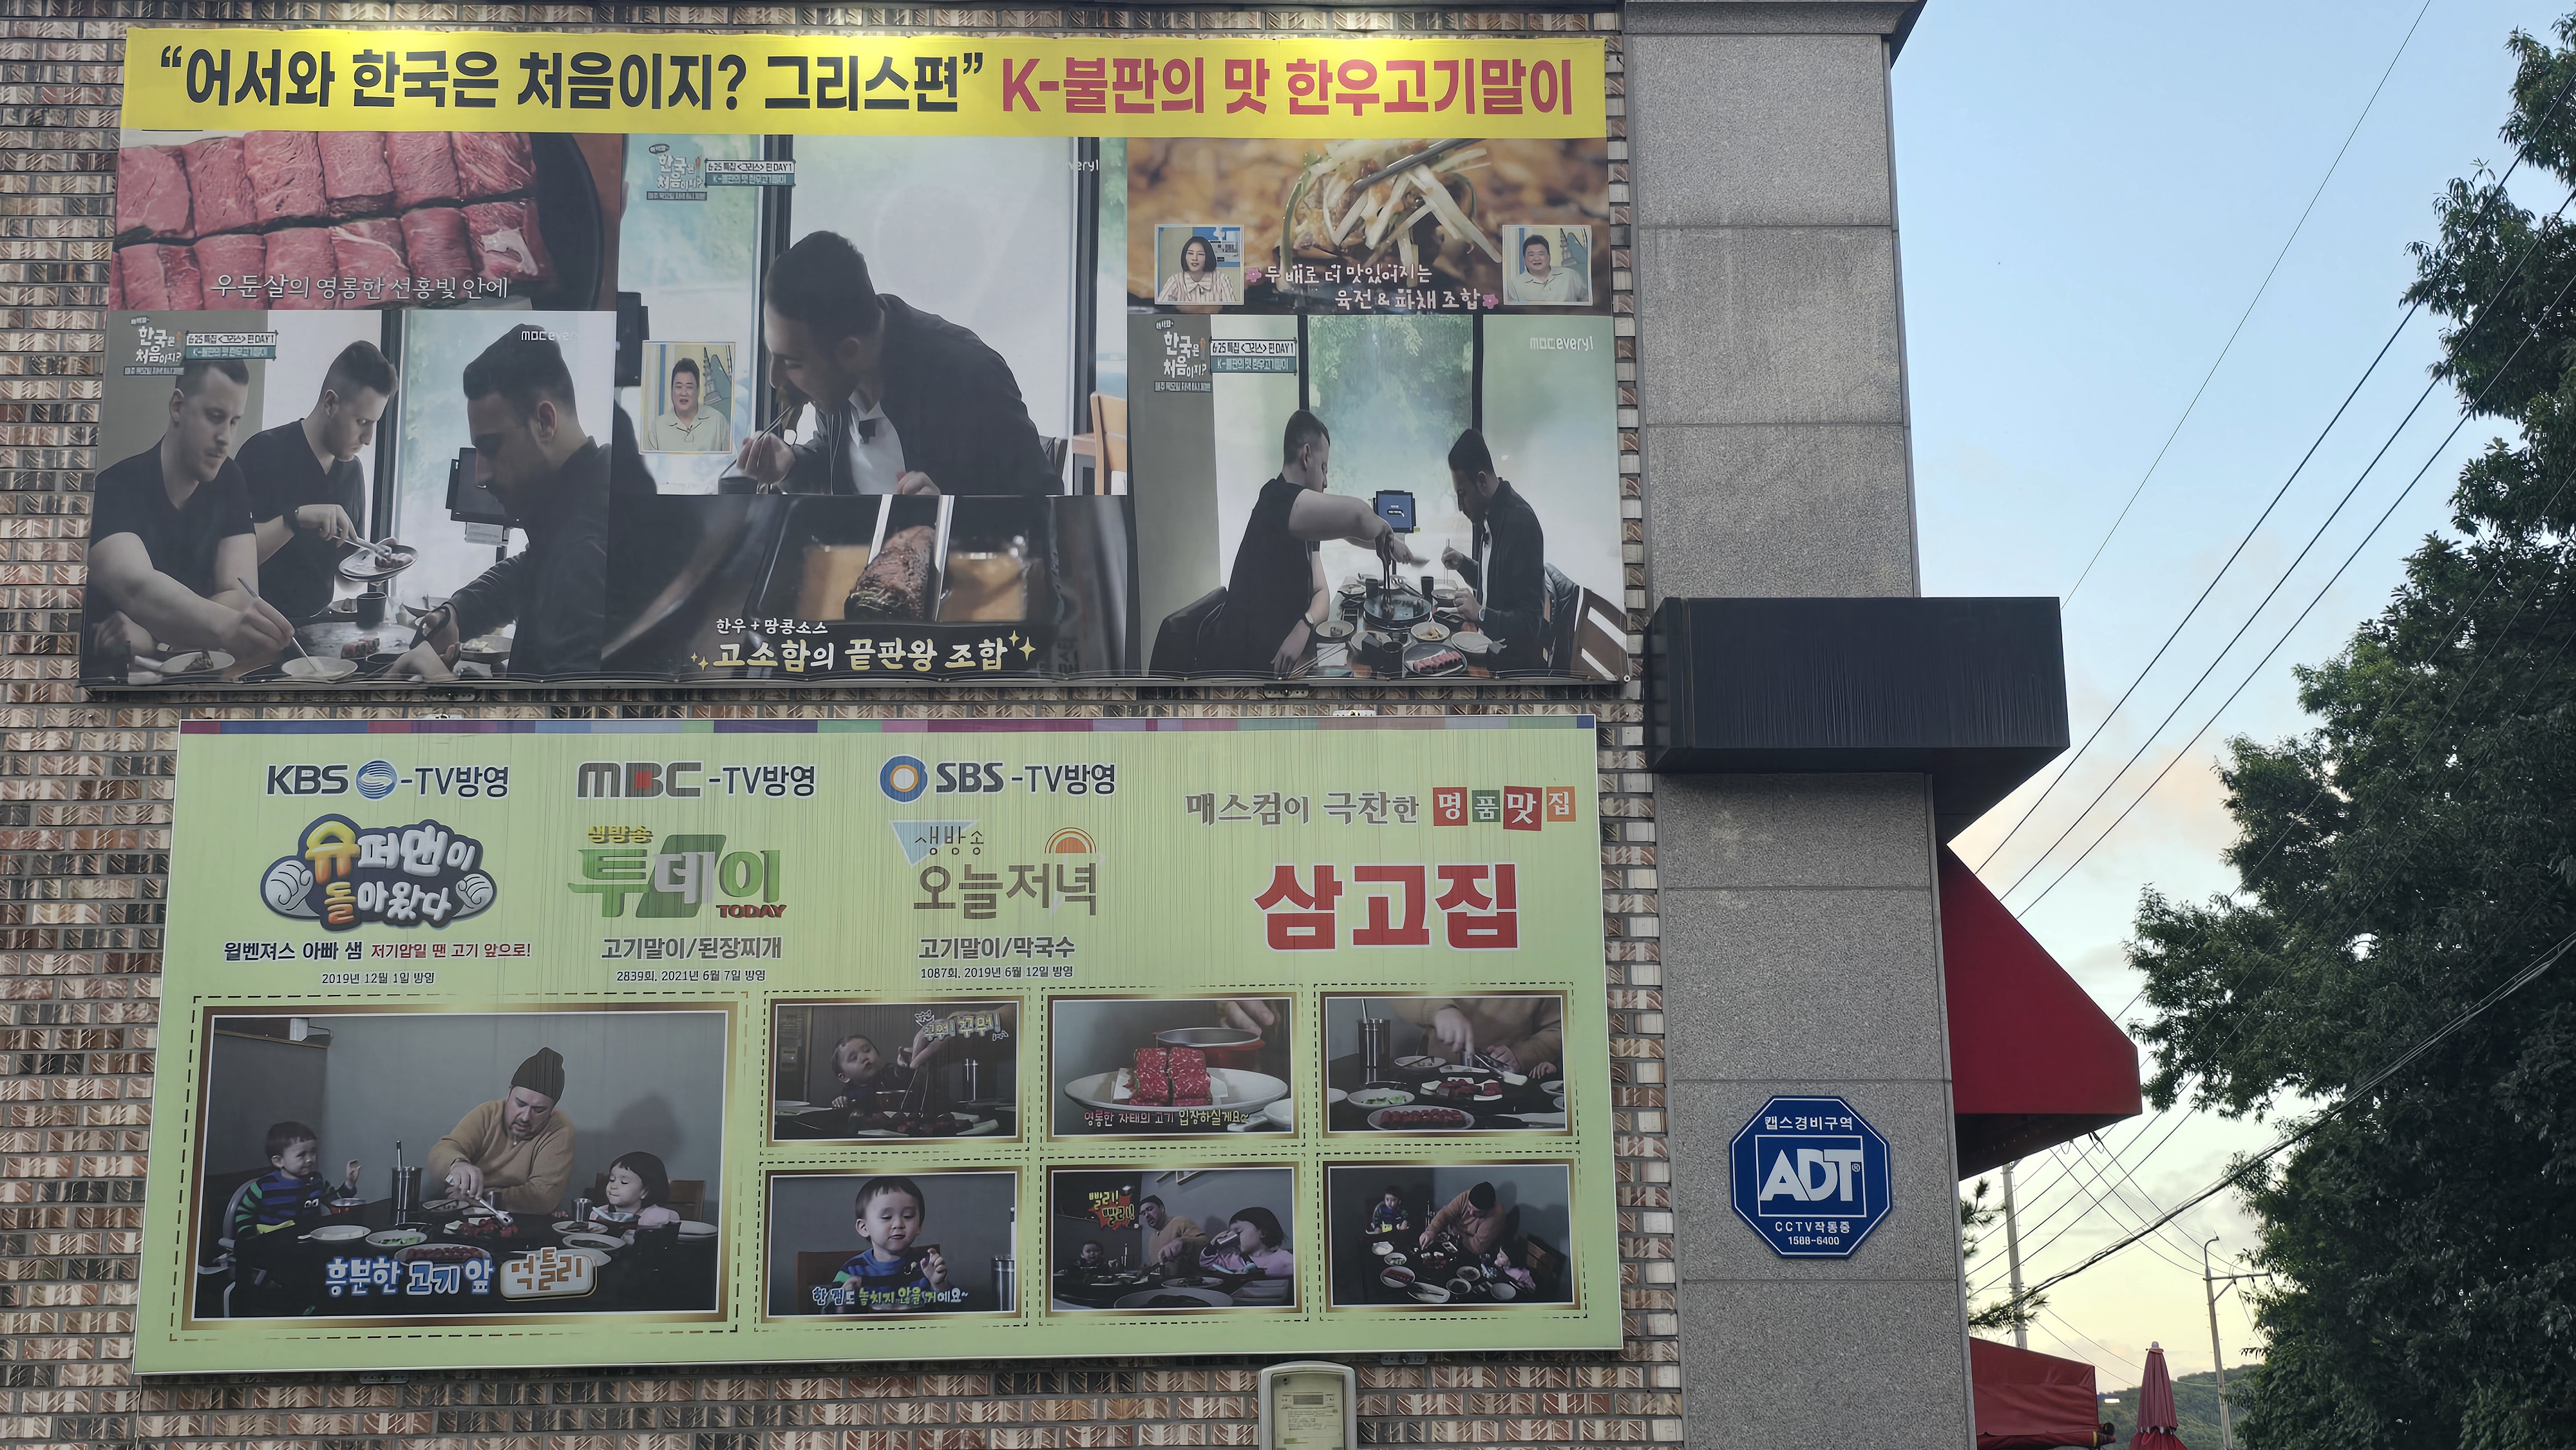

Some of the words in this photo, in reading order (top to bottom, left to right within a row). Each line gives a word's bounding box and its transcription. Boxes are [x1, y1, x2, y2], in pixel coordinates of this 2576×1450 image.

[160, 44, 335, 108] “어서와
[352, 48, 499, 109] 한국은
[517, 52, 747, 110] 처음이지?
[764, 52, 983, 112] 그리스편”
[1001, 57, 1204, 115] K-불판의
[1224, 58, 1270, 115] 맛
[1285, 58, 1572, 117] 한우고기말이
[1325, 264, 1341, 284] 더
[1346, 263, 1434, 285] 맛있어지는
[210, 274, 310, 299] 우둔살의
[316, 276, 386, 301] 영롱한
[390, 277, 457, 301] 선홍빛
[462, 277, 509, 300] 안에
[1335, 289, 1372, 310] 육전
[1377, 291, 1390, 306] &
[1395, 288, 1437, 310] 파채
[1442, 288, 1481, 310] 조합
[138, 326, 175, 348] 한국은
[1164, 331, 1199, 359] 한국은
[1164, 355, 1207, 379] 처음이지?
[715, 618, 746, 635] 한우
[764, 618, 829, 635] 땅콩소스
[713, 639, 835, 672] 고소함의
[844, 637, 938, 672] 끝판왕
[944, 639, 1009, 671] 조합
[267, 764, 348, 795] KBS
[1185, 792, 1309, 827] 매스컴이
[1323, 791, 1419, 825] 극찬한
[914, 826, 984, 855] 생방송
[304, 820, 476, 885] 슈퍼맨이
[567, 848, 781, 918] 투데이
[323, 881, 452, 925] 돌아왔다
[716, 905, 787, 918] TODAY
[1254, 863, 1519, 950] 삼고집
[224, 942, 296, 961] 윌벤져스
[303, 941, 339, 961] 아빠
[345, 941, 363, 961] 샘
[371, 943, 427, 958] 저기압일
[432, 943, 446, 958] 땐
[451, 943, 479, 958] 고기
[484, 943, 531, 958] 앞으로!
[601, 937, 782, 959] 고기말이/된장찌개
[918, 936, 1075, 959] 고기말이/막국수
[321, 973, 360, 984] 2019년
[365, 972, 388, 984] 12월
[393, 972, 410, 984] 1일
[413, 972, 435, 984] 방영
[661, 970, 699, 981] 2021년
[703, 970, 720, 981] 6월
[724, 970, 741, 981] 7일
[745, 970, 766, 981] 방영
[965, 967, 1001, 978] 2019년
[1005, 967, 1022, 978] 6월
[1026, 966, 1048, 978] 12일
[1052, 966, 1074, 977] 방영
[1084, 1110, 1114, 1126] 영롱한
[1119, 1112, 1151, 1124] 자태의
[1155, 1111, 1174, 1124] 고기
[1764, 1116, 1853, 1131] 캡스경비구역
[1759, 1149, 1862, 1201] ADT
[1775, 1221, 1850, 1234] CCTV작동중
[1788, 1236, 1840, 1245] 1588-6400
[325, 1256, 402, 1297] 흥분한
[406, 1260, 462, 1295] 고기
[464, 1257, 495, 1295] 앞
[859, 1287, 895, 1306] 놓치지
[898, 1286, 921, 1305] 않을
